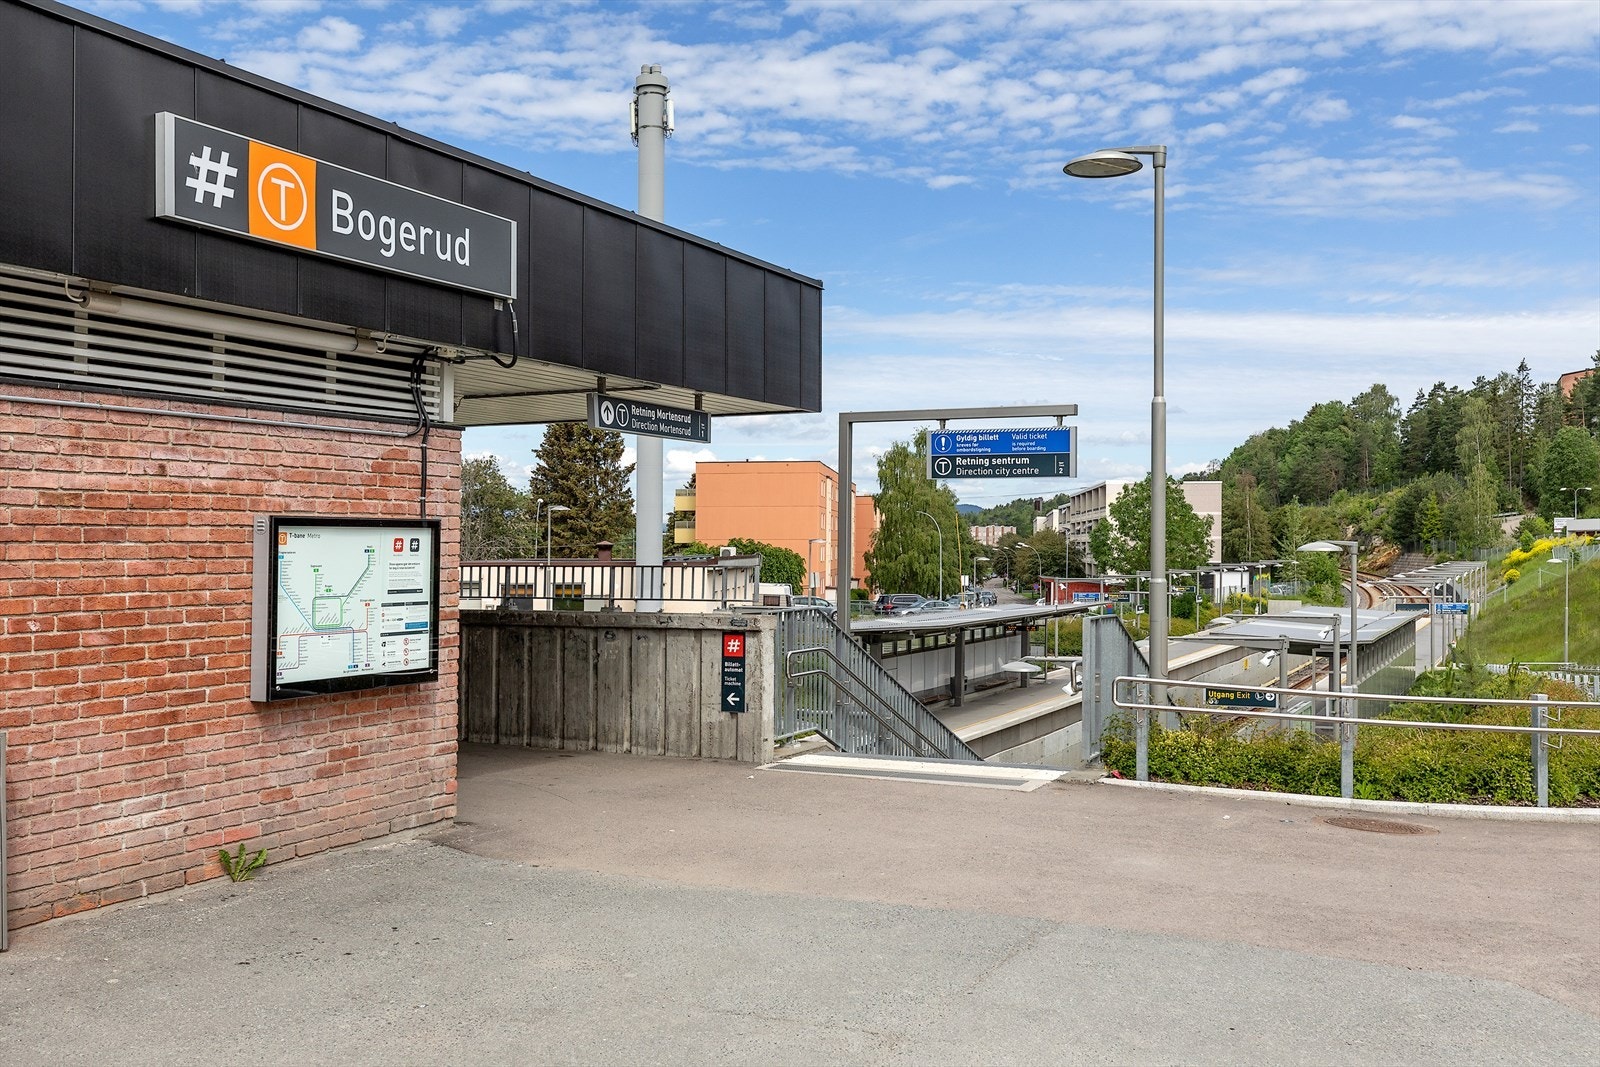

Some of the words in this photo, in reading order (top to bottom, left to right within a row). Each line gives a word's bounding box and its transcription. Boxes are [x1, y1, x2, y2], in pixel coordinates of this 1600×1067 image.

[331, 188, 471, 267] Bogerud
[631, 405, 656, 420] Retning
[656, 408, 692, 424] Mortensrud
[631, 418, 658, 431] Direction
[659, 422, 692, 436] Mortensrud
[955, 434, 977, 443] Gyldig
[978, 433, 999, 441] billett
[1029, 432, 1048, 440] ticket
[955, 456, 990, 467] Retning
[991, 457, 1030, 465] sentrum
[955, 467, 993, 476] Direction
[995, 467, 1010, 477] city
[1012, 467, 1040, 475] centre
[1208, 690, 1235, 700] Utgang
[1236, 691, 1251, 699] Exit
